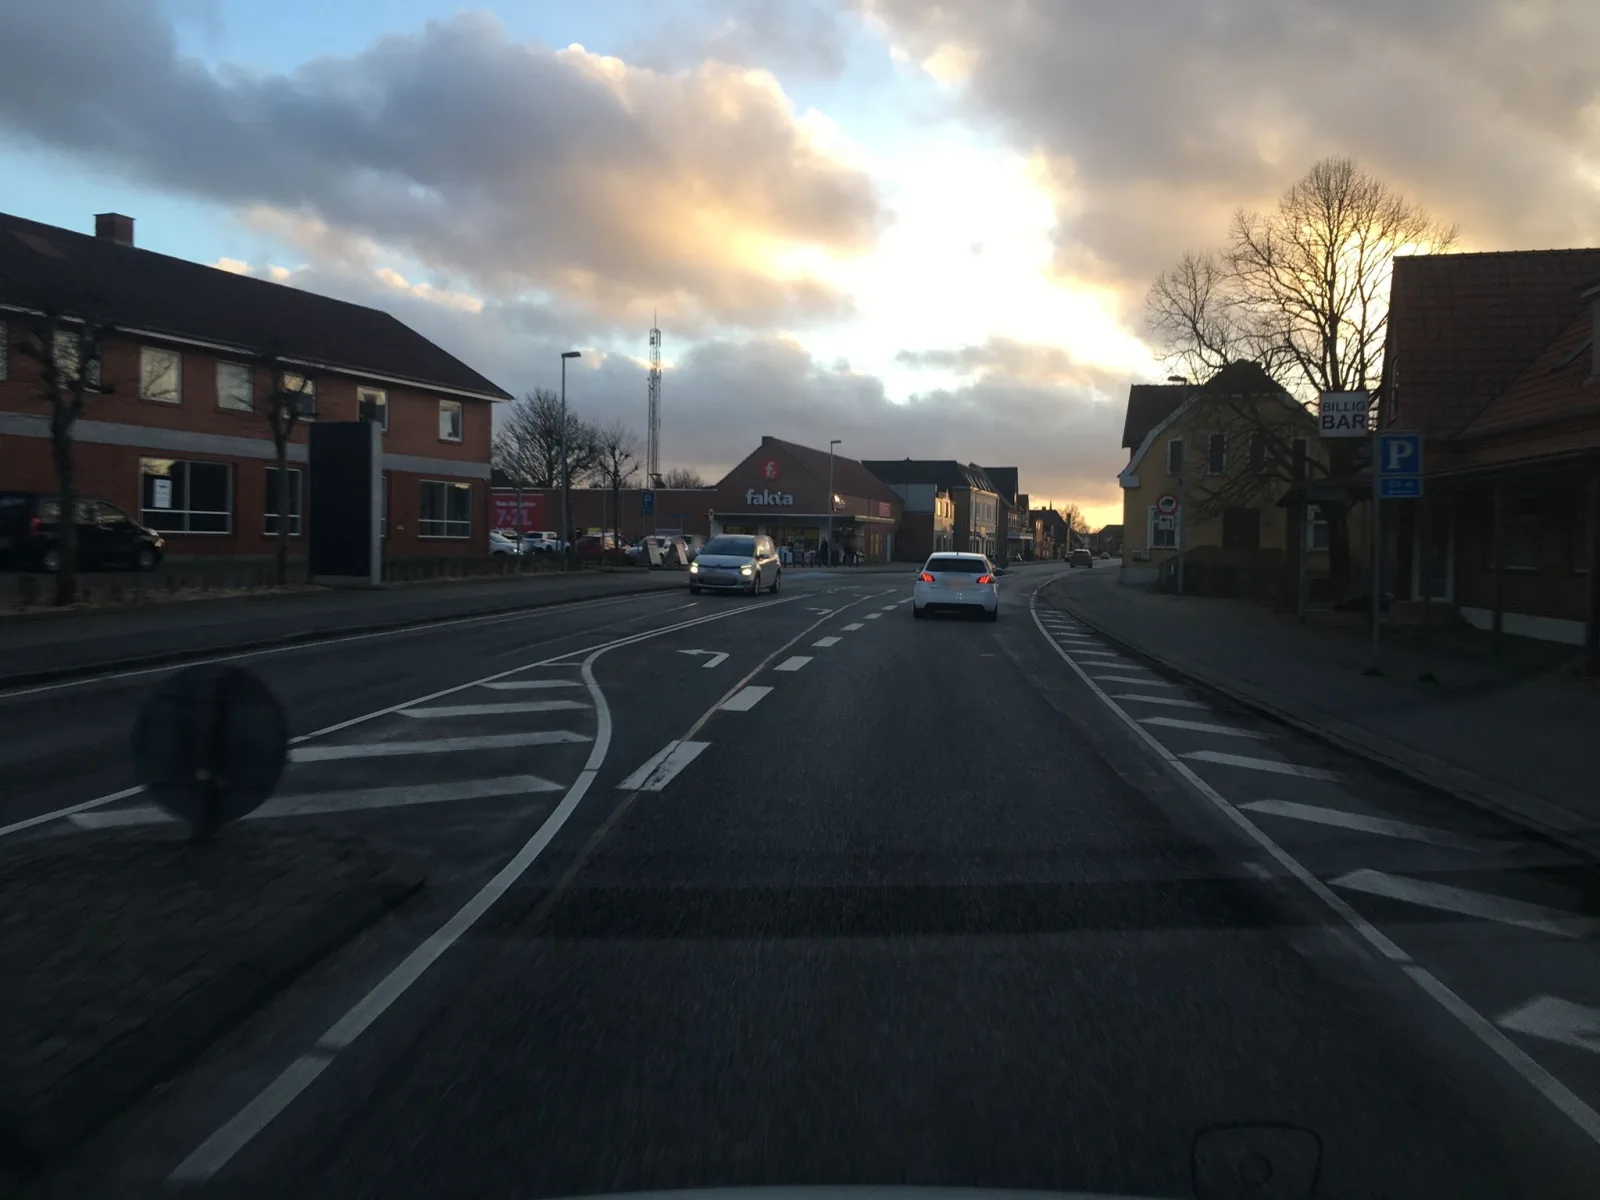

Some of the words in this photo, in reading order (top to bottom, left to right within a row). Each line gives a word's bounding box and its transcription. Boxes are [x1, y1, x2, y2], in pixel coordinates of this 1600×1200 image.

[1322, 401, 1366, 412] BILLIG
[1322, 414, 1366, 430] BAR
[1387, 440, 1413, 469] P
[745, 488, 794, 506] fakta
